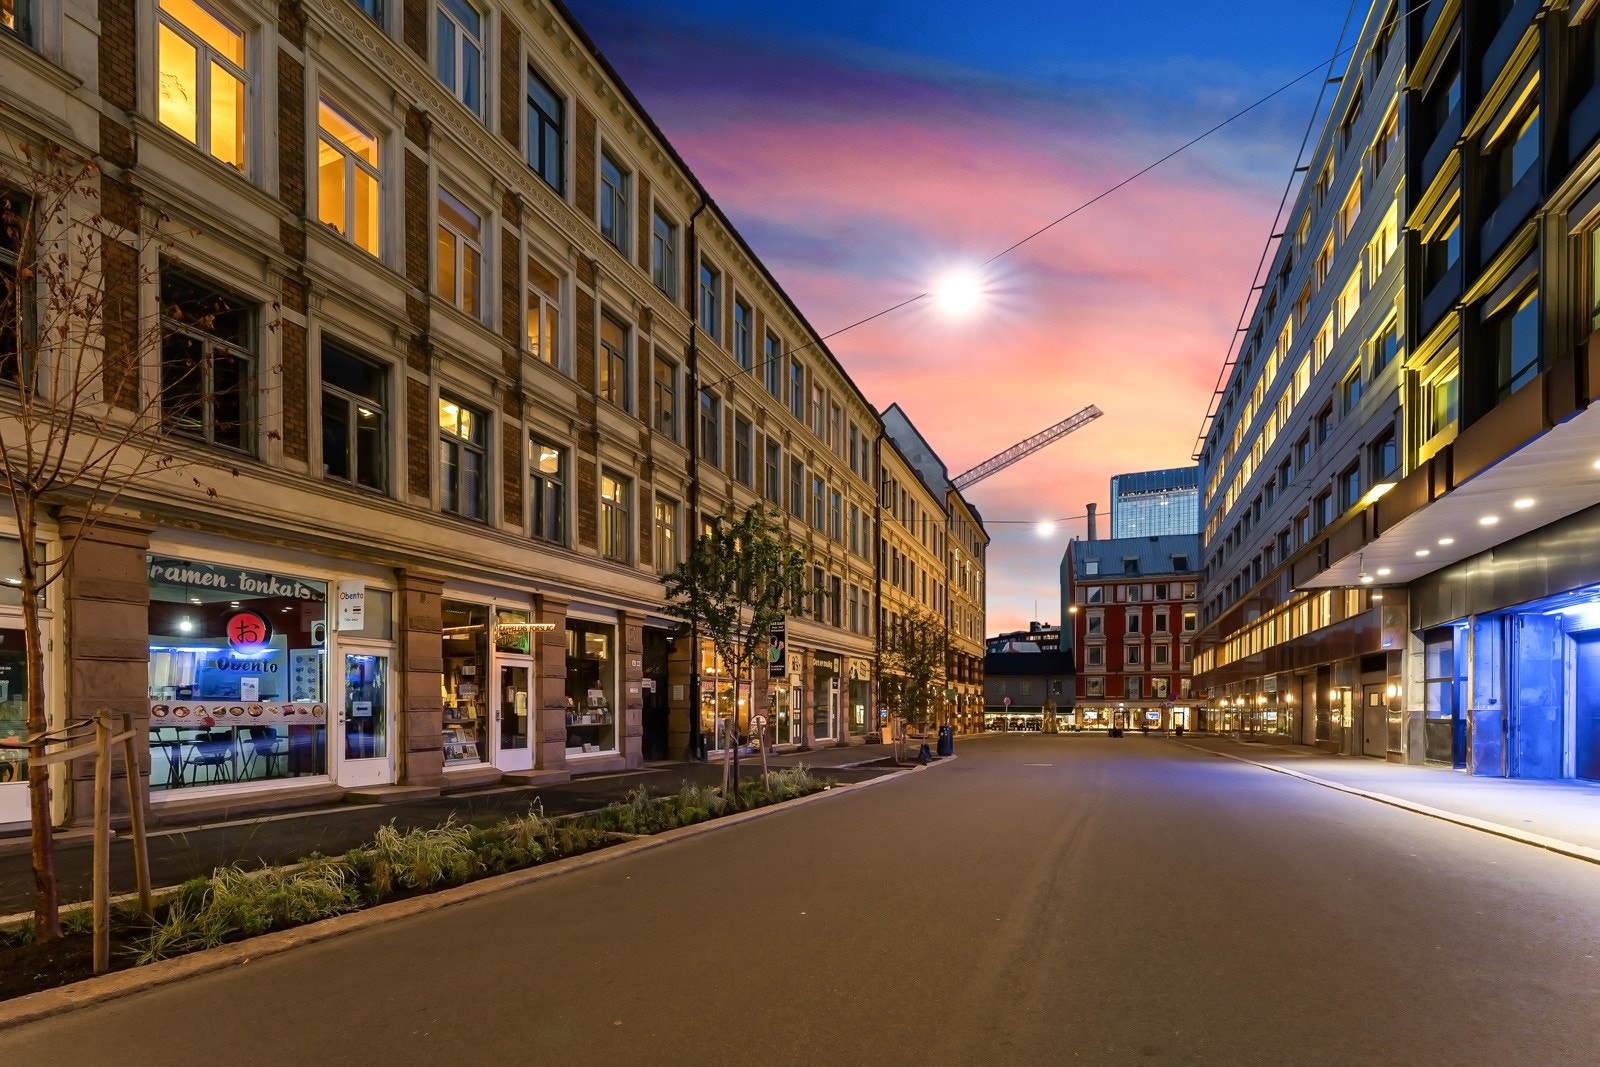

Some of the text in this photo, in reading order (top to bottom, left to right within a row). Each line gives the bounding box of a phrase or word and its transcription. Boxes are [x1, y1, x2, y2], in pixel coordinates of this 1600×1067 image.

[150, 565, 228, 588] ramen
[340, 591, 364, 600] Obento
[235, 620, 260, 643] お
[217, 655, 278, 673] Obento
